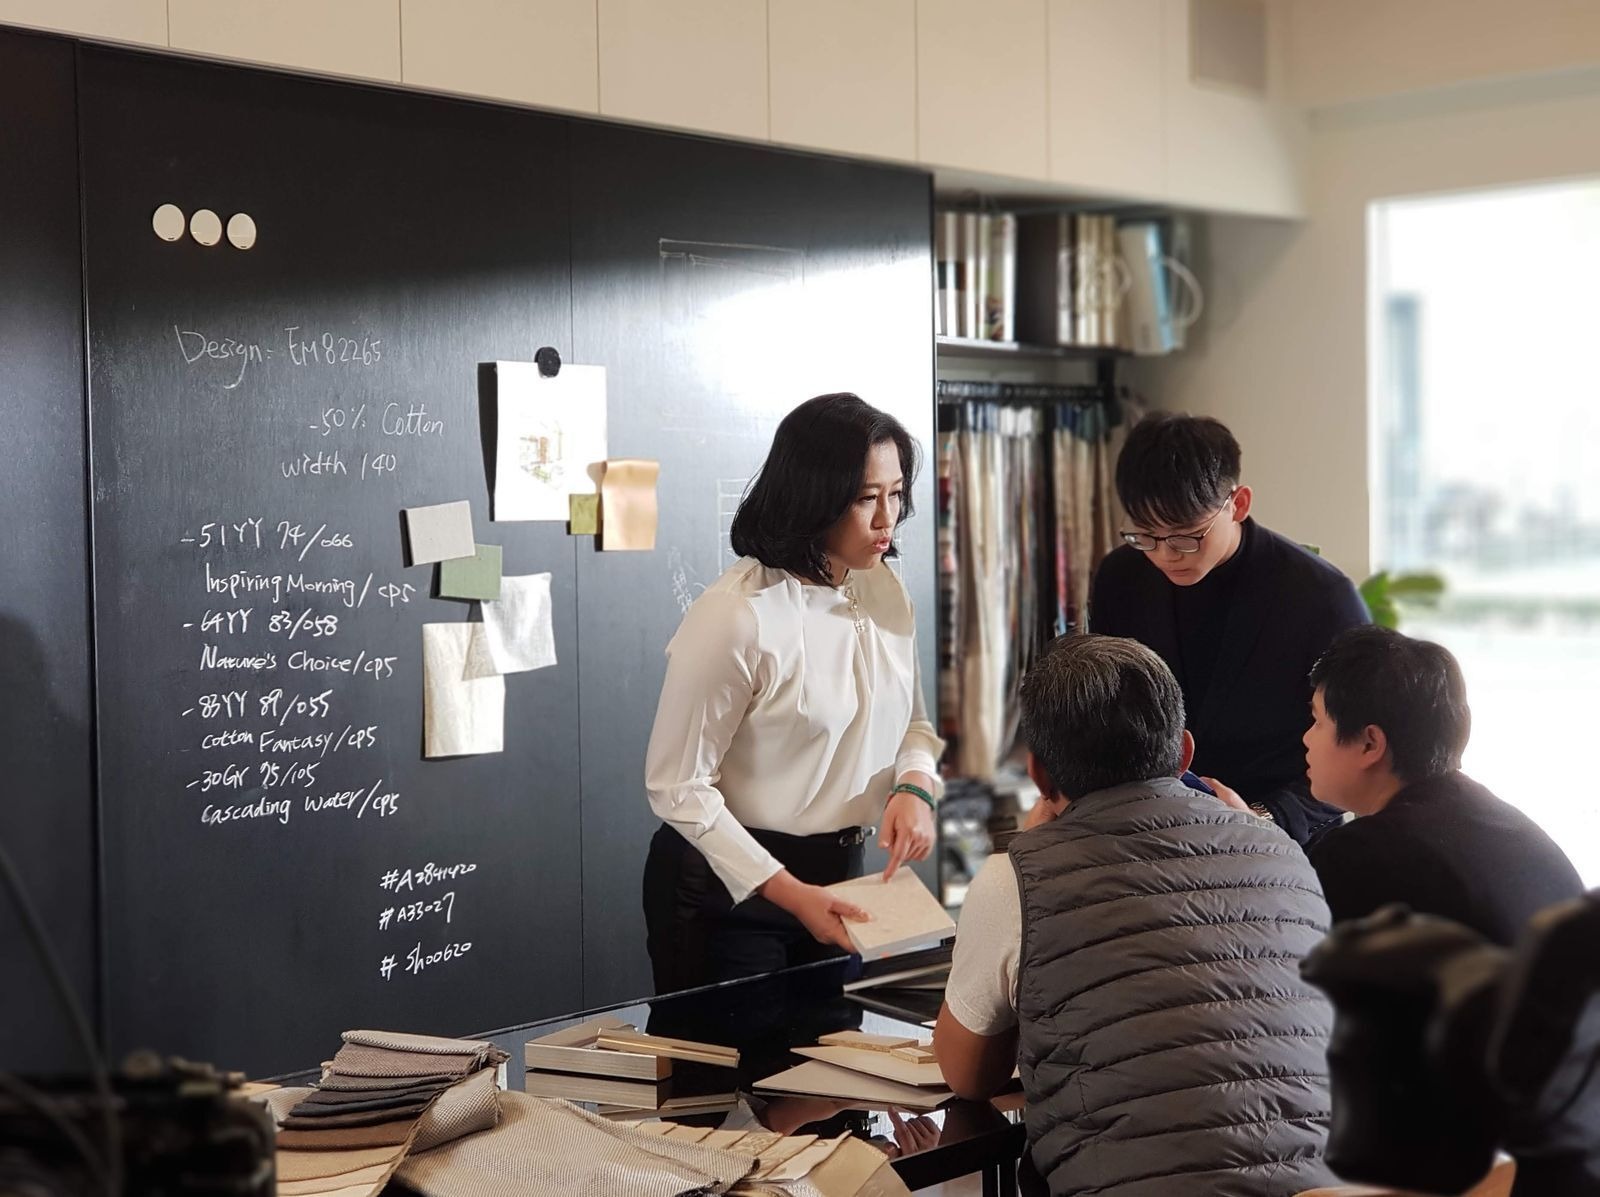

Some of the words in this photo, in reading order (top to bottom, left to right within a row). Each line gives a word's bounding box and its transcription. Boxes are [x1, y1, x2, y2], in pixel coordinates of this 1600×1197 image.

[381, 401, 445, 437] Cotton
[280, 451, 347, 479] width
[205, 562, 283, 604] Inspiring
[267, 607, 339, 640] 83/058
[199, 643, 278, 671] Nature's
[259, 688, 333, 727] 89/055
